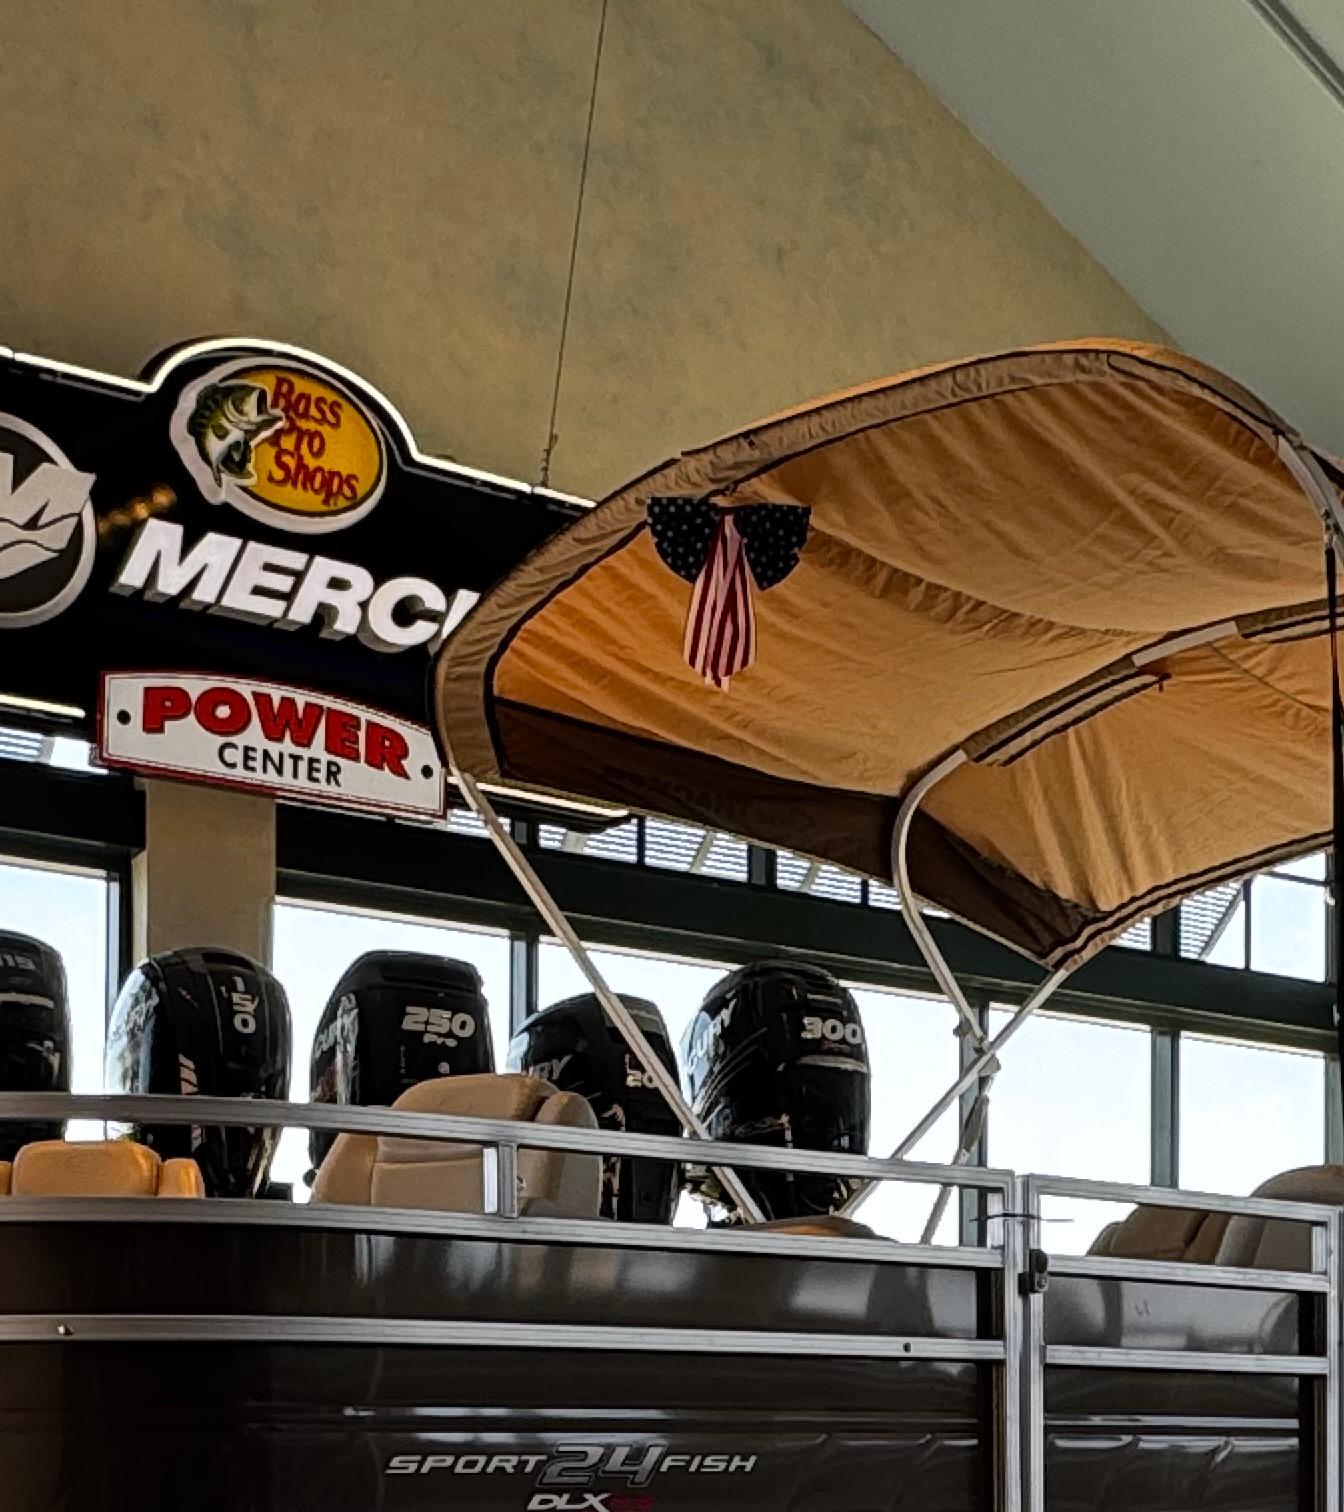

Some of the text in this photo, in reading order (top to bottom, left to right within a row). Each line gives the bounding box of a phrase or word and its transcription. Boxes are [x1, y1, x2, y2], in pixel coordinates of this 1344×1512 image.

[270, 375, 343, 430] Bass
[270, 416, 325, 459] Pro
[267, 449, 359, 507] Shops
[112, 518, 480, 649] MERC
[142, 686, 411, 780] POWER
[218, 742, 342, 787] CENTER
[401, 1006, 475, 1038] 250
[801, 1016, 862, 1044] 300
[386, 1441, 758, 1488] SPORT 24 FISH
